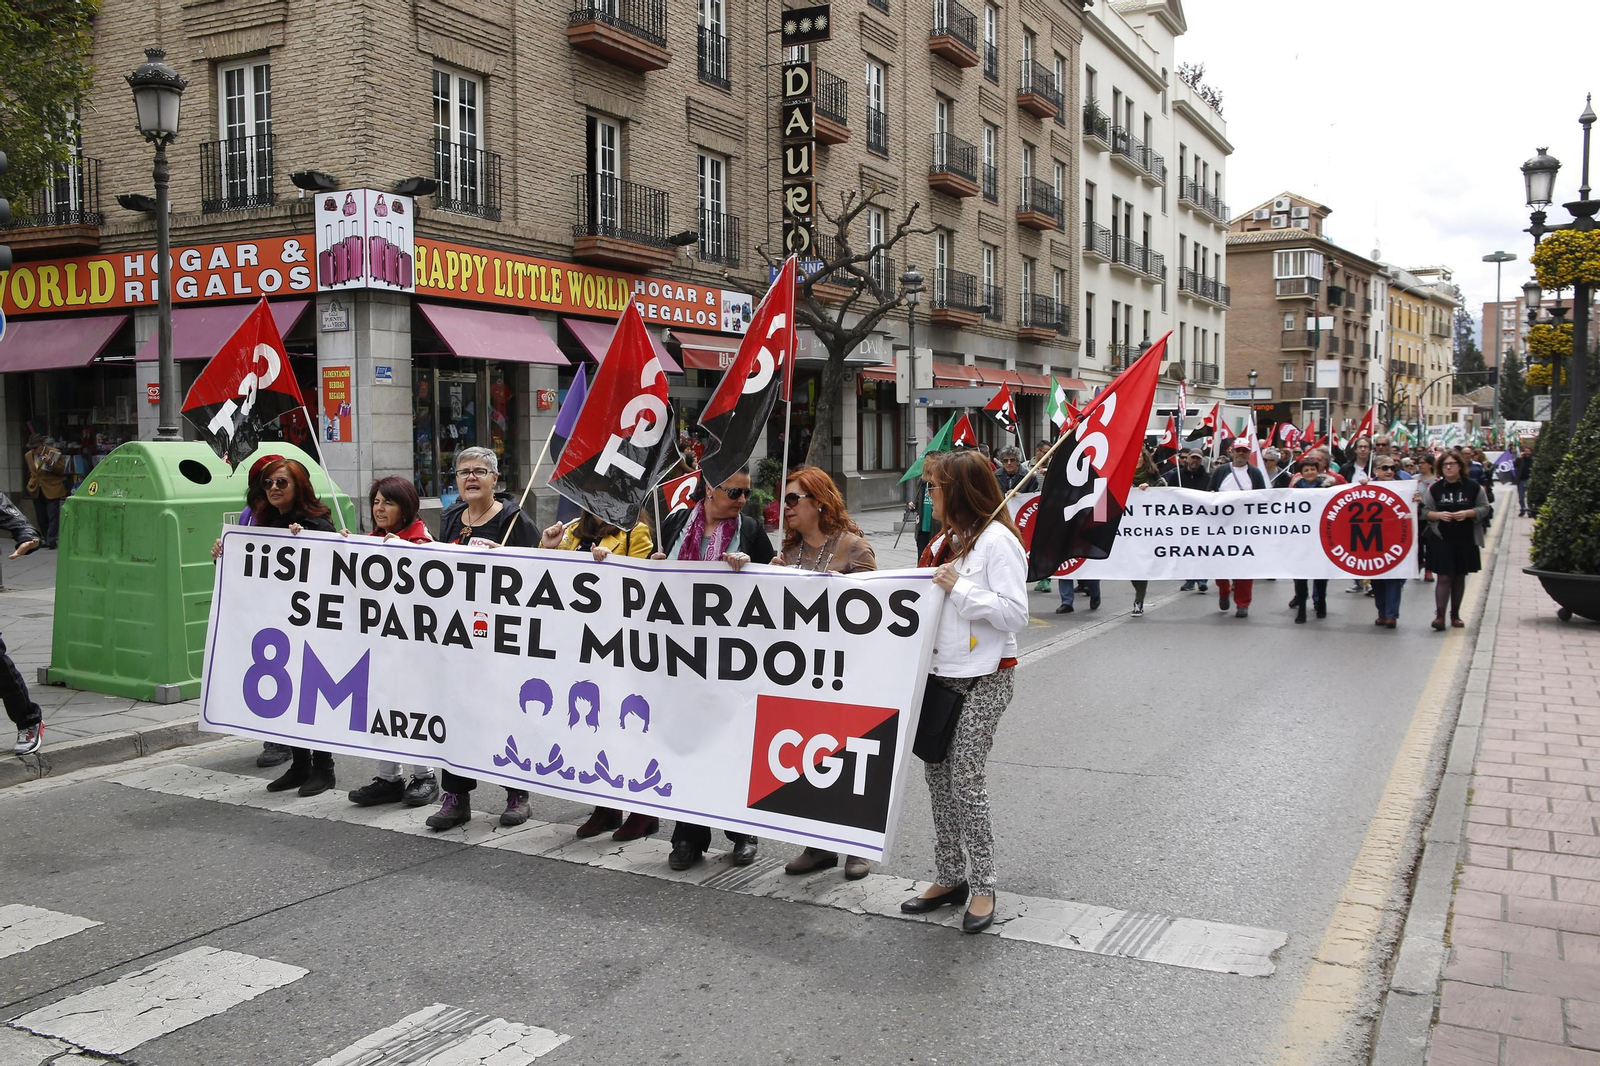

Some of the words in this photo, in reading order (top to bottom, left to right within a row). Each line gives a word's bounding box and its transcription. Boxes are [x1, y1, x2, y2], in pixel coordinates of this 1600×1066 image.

[280, 239, 308, 264] &
[414, 244, 489, 294] HAPPY
[493, 258, 563, 305] LITTLE
[566, 269, 629, 311] WORLD
[634, 279, 698, 303] HOGAR
[705, 291, 716, 306] &
[636, 301, 717, 327] REGALOS
[328, 381, 345, 389] BEBIDAS
[328, 391, 345, 400] REGALOS
[1142, 504, 1235, 516] TRABAJO
[1244, 501, 1311, 515] TECHO
[1326, 490, 1376, 521] MARCHAS
[1378, 493, 1395, 506] DE
[1392, 504, 1406, 519] LA
[1348, 501, 1384, 523] 22
[1115, 527, 1174, 537] ARCHAS
[1180, 526, 1201, 536] DE
[1207, 526, 1226, 536] LA
[1233, 524, 1311, 535] DIGNIDAD
[1350, 523, 1384, 552] M
[1154, 545, 1255, 558] GRANADA
[1331, 544, 1403, 570] DIGNIDAD
[330, 552, 602, 613] NOSOTRAS
[622, 576, 922, 638] PARAMOS
[287, 590, 344, 630] SE
[359, 597, 473, 650] PARA
[494, 614, 556, 660] EL
[579, 623, 845, 692] MUNDO!!
[473, 629, 487, 637] CGT
[767, 728, 881, 796] CGT
